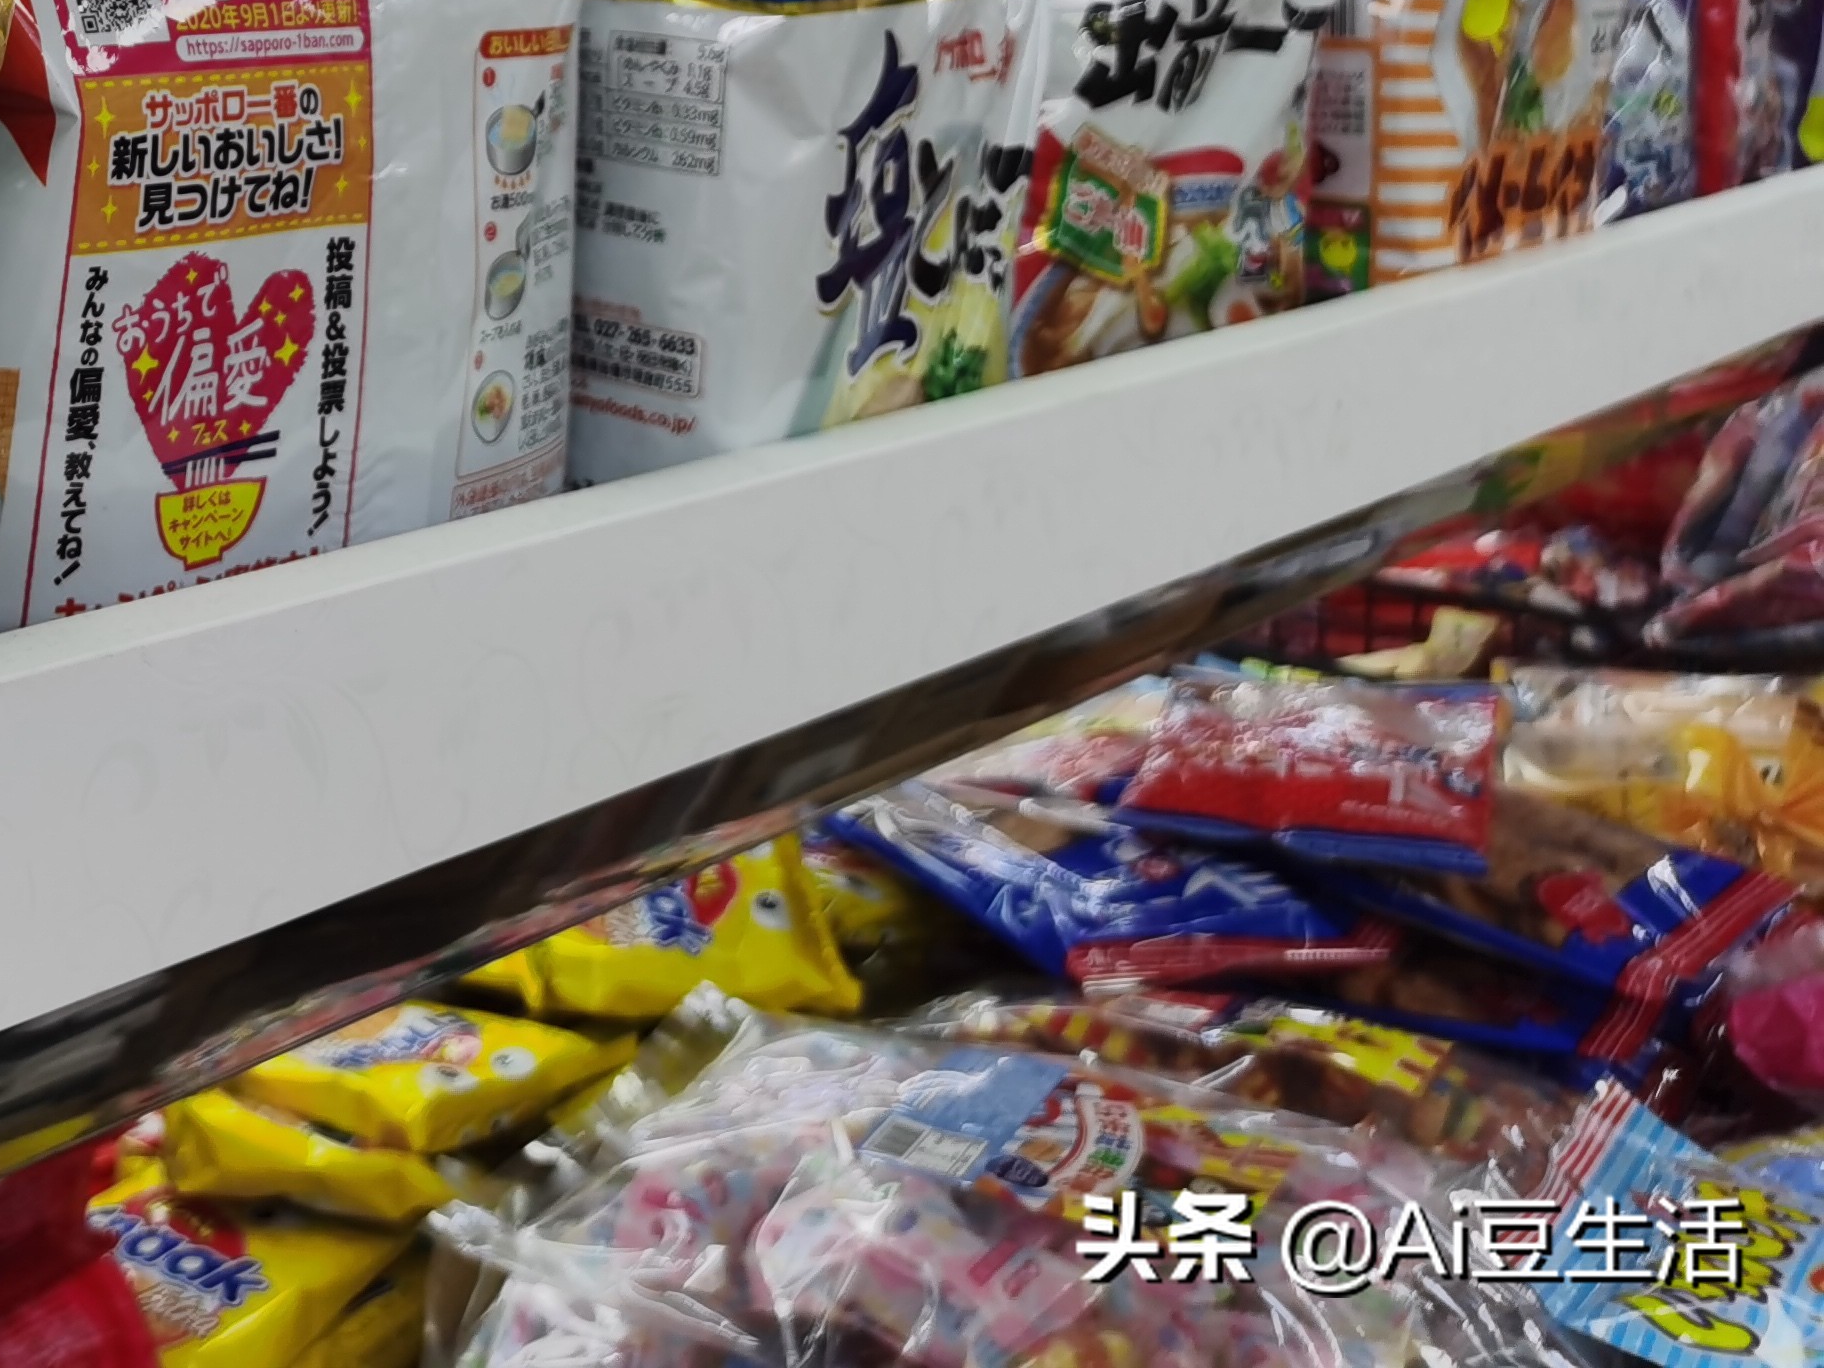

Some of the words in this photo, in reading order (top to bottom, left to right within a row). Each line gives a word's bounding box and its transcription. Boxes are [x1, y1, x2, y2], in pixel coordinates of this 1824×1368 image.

[186, 32, 354, 58] https://sapporo-1ban.com
[145, 84, 319, 130] サッポロ一番の
[110, 118, 344, 182] 新しいおいしさ!
[137, 169, 313, 232] 見つけてね!
[113, 275, 231, 356] おうちで
[148, 317, 272, 426] 偏愛
[307, 236, 355, 536] 投稿&投票しよう!
[53, 264, 110, 586] みんなの偏愛、教えてね!
[191, 419, 229, 445] フェス
[168, 506, 244, 533] キャンペーン
[182, 490, 232, 513] 詳しくは
